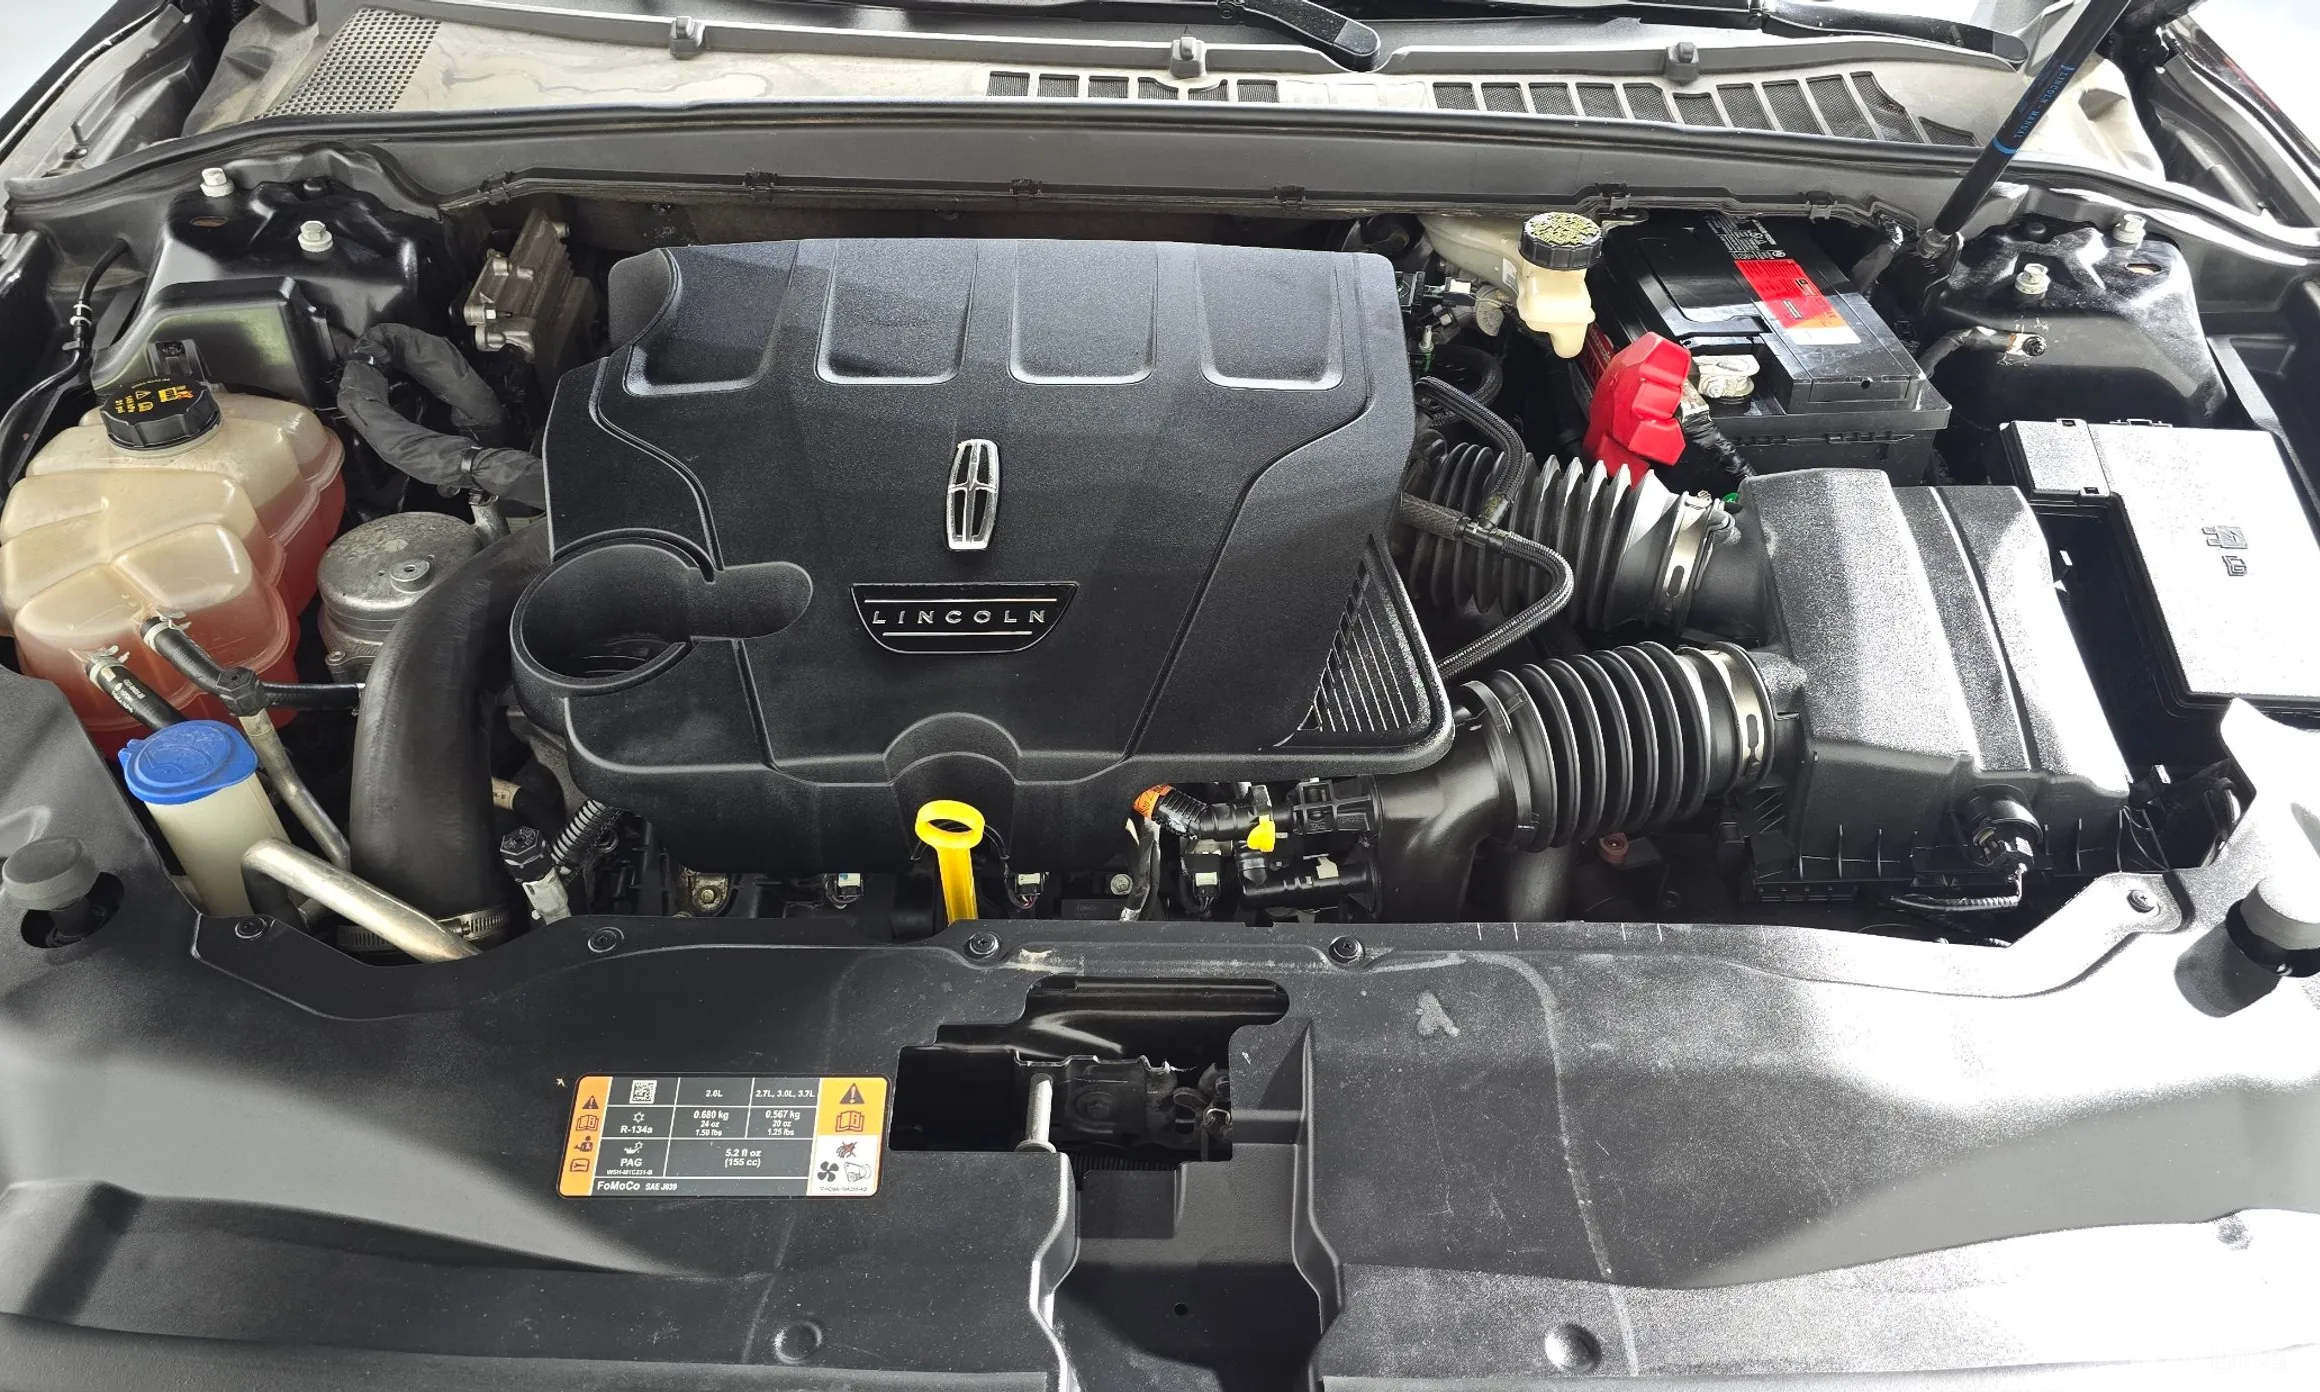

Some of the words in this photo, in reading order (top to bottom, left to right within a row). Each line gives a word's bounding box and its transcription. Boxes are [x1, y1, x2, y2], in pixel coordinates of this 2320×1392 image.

[872, 610, 1045, 624] LINCOLN
[705, 1089, 723, 1097] 2.0L
[755, 1089, 775, 1098] 2.7L,
[777, 1089, 796, 1098] 3.0L,
[798, 1089, 816, 1097] 3.7L
[693, 1110, 717, 1119] 0.680
[718, 1110, 729, 1121] kg
[765, 1110, 788, 1118] 0.567
[789, 1110, 800, 1120] kg
[620, 1125, 653, 1134] R-134a
[767, 1128, 782, 1136] 1.25
[783, 1128, 795, 1136] lbs
[725, 1148, 740, 1157] 5.2
[741, 1148, 748, 1157] fl
[620, 1158, 643, 1167] PAG
[724, 1157, 745, 1168] (155
[746, 1157, 761, 1168] cc)
[597, 1181, 641, 1191] FoMoCo
